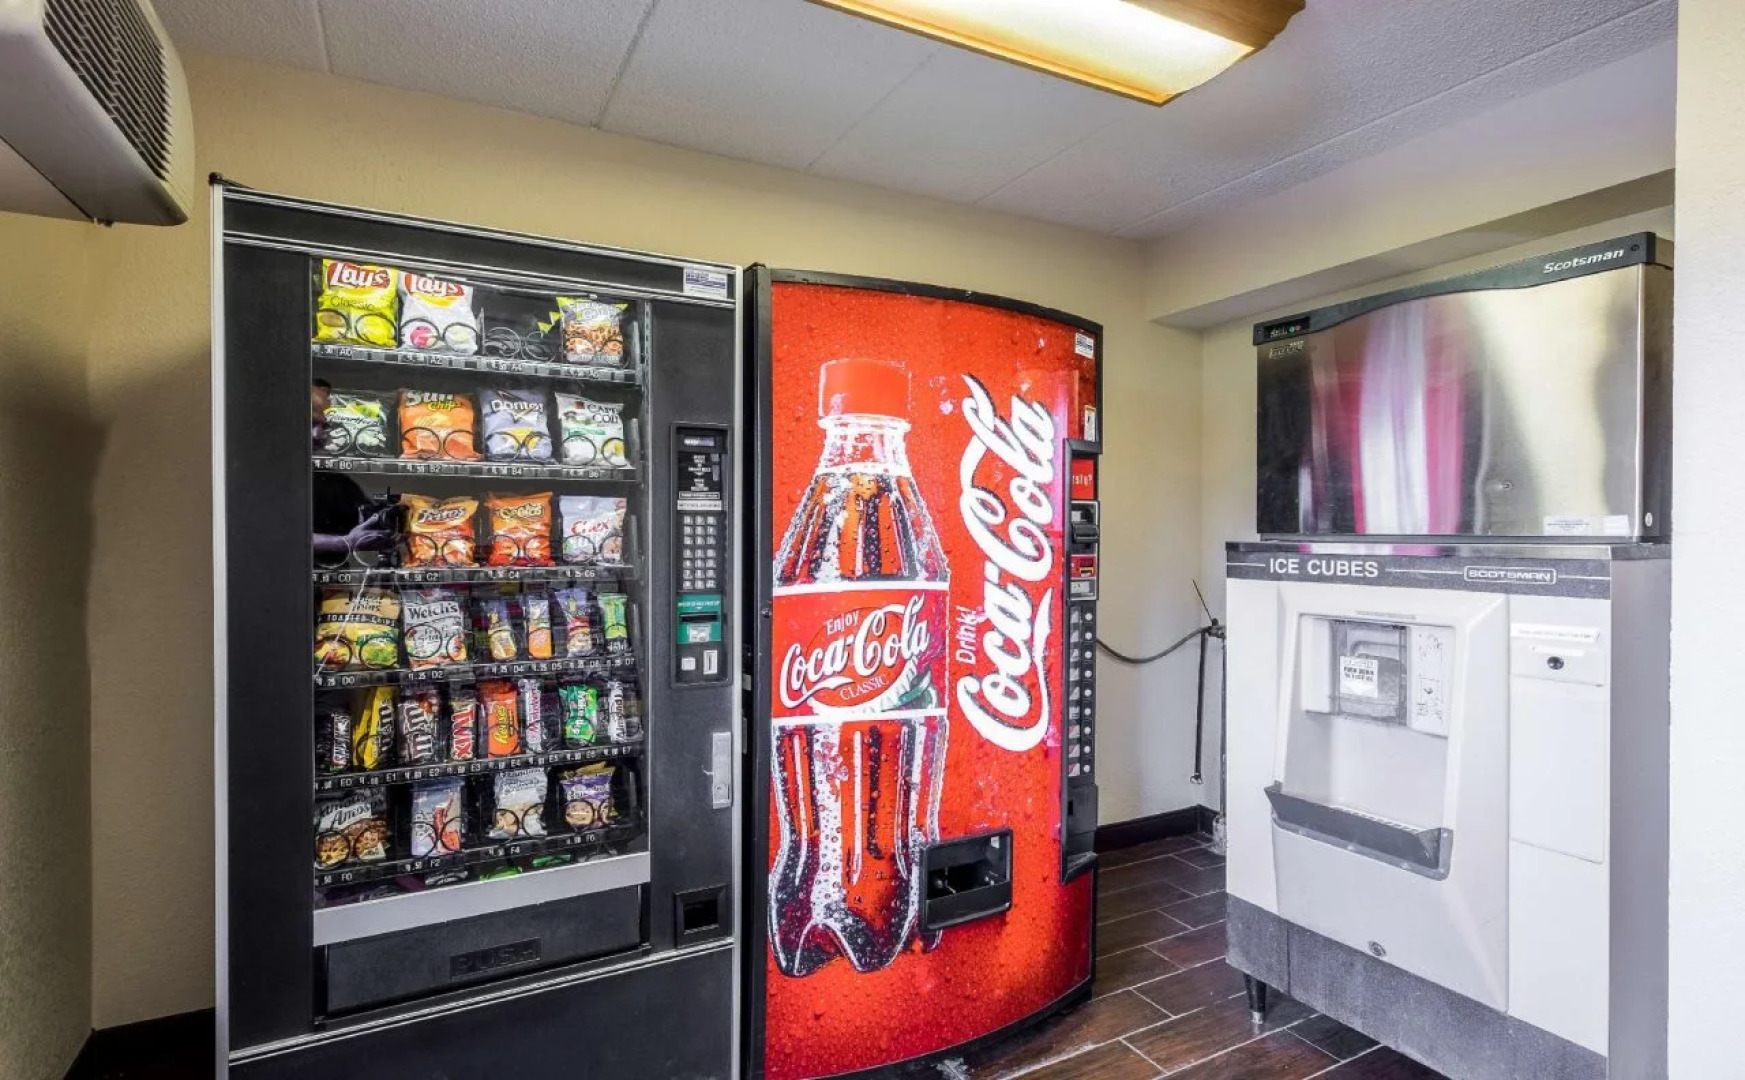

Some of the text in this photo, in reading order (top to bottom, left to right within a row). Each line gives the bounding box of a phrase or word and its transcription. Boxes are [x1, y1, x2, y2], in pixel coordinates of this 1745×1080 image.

[1543, 249, 1625, 274] Scotsman
[957, 373, 1054, 751] Coca-Cola
[1270, 558, 1379, 578] ICE CUBES
[426, 572, 439, 582] C2
[1469, 569, 1552, 582] SCOTSMAN
[408, 603, 459, 619] Welch's
[826, 610, 860, 635] Enjoy
[779, 592, 931, 709] Coca-Cola
[431, 670, 444, 679] D2
[513, 665, 524, 673] D4
[839, 674, 890, 701] CLASSIC
[386, 772, 397, 781] E1
[429, 768, 440, 777] E2
[330, 804, 371, 830] Amos
[510, 846, 520, 854] F4
[430, 859, 440, 867] F2
